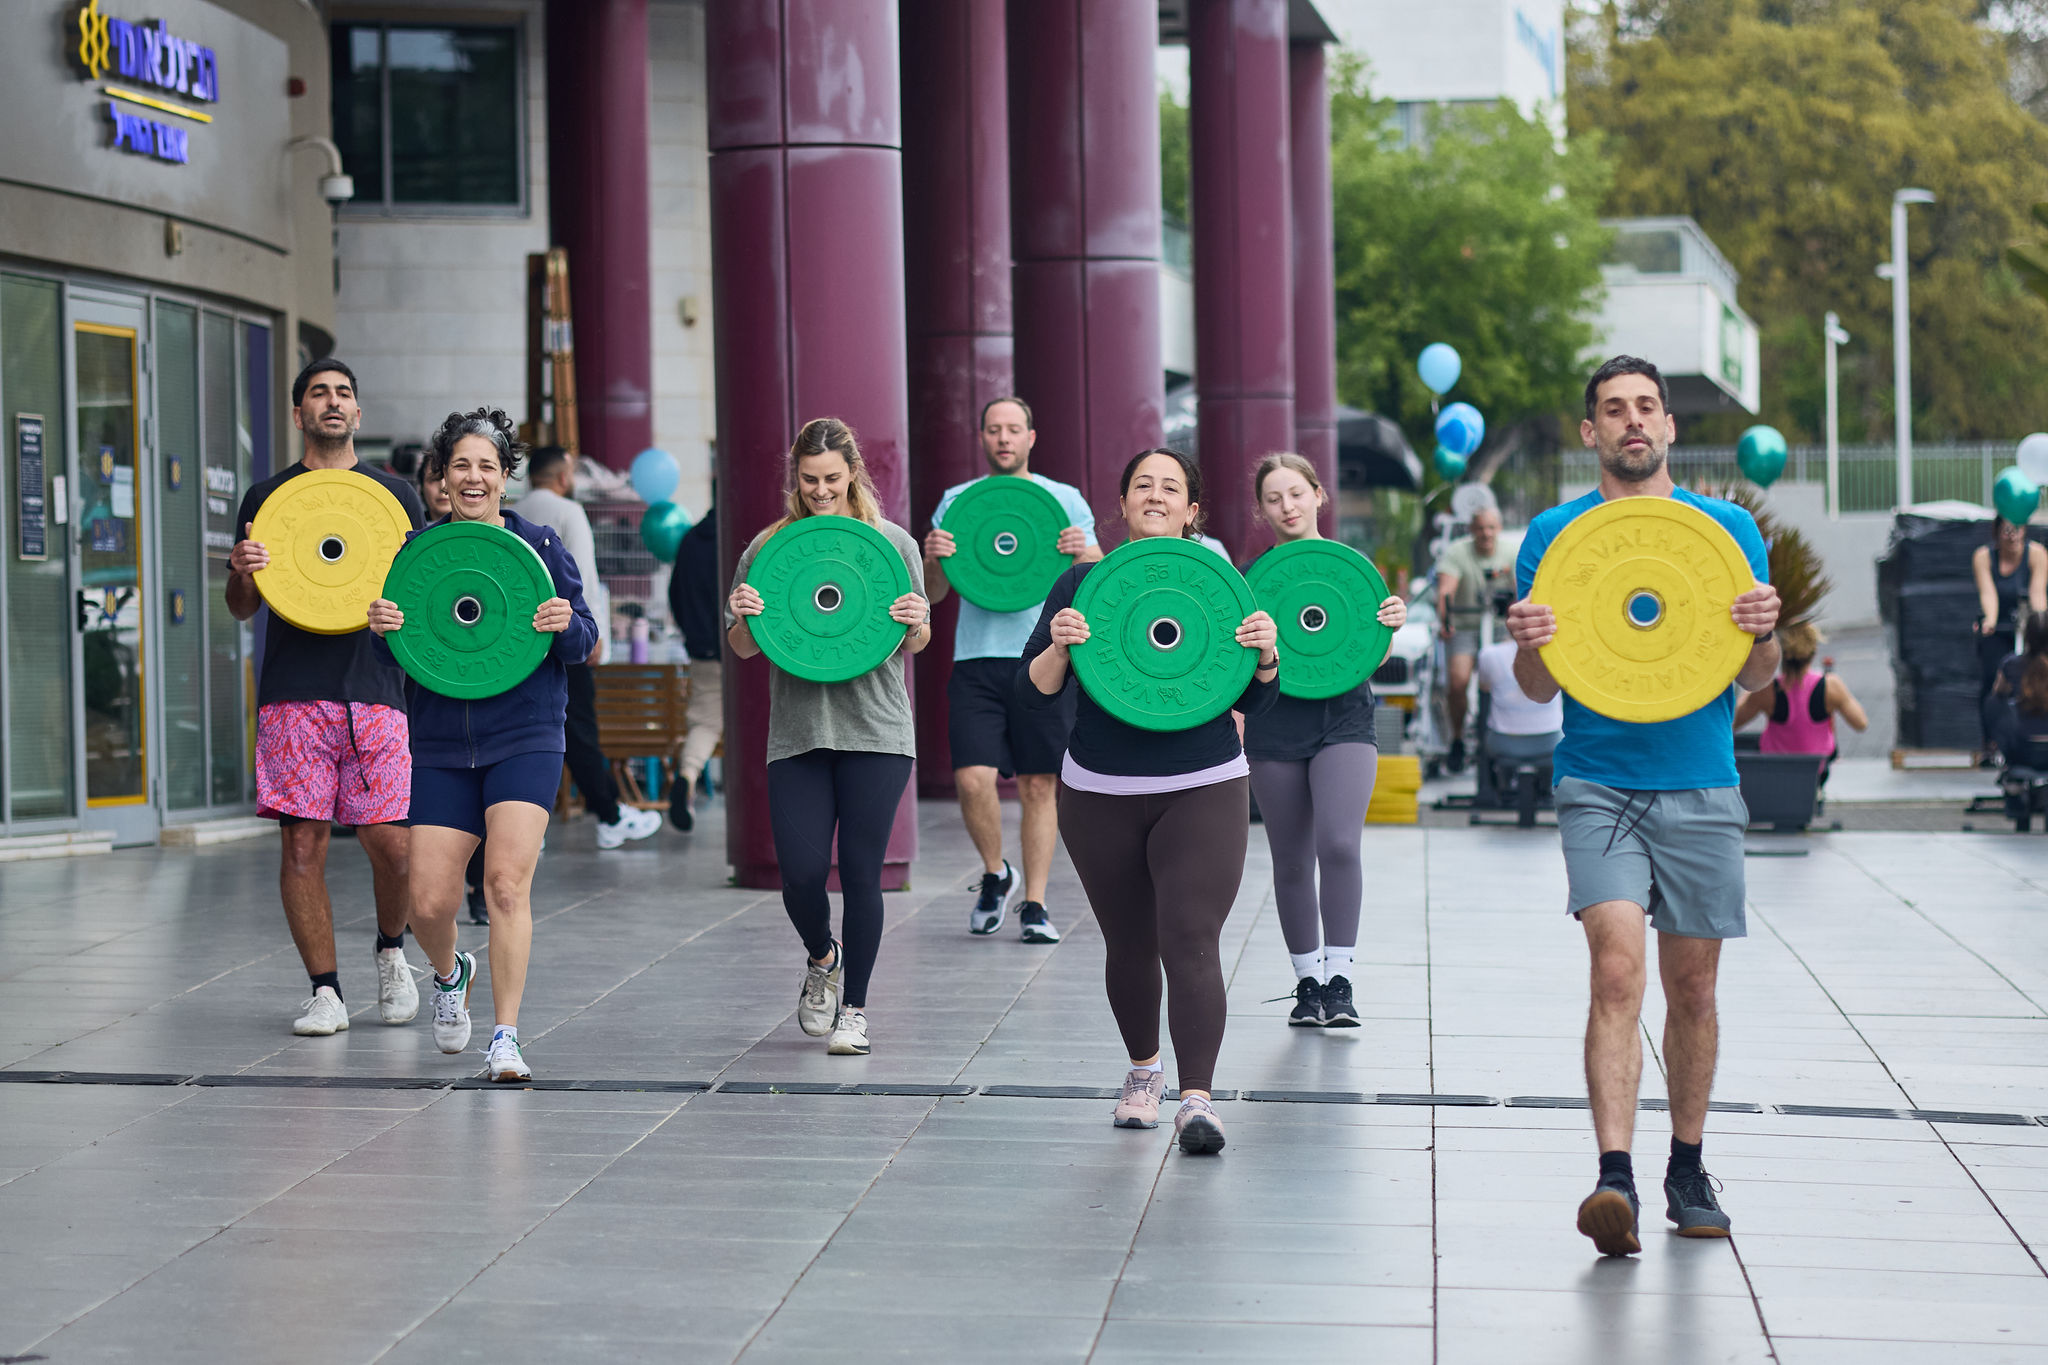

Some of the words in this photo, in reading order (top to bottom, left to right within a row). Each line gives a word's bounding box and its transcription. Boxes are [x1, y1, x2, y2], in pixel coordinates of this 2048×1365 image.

[110, 17, 219, 103] הבינלאומי
[406, 545, 480, 641] VALHALLA
[766, 537, 845, 629] VALHALLA
[811, 571, 889, 660] VALHALLA
[1280, 561, 1370, 631] VALHALLA
[1590, 528, 1728, 617] VALHALLA
[457, 574, 531, 676] VALHALLA
[1095, 577, 1151, 703] VALHALLA
[1177, 565, 1236, 692] VALHALLA
[1562, 605, 1699, 693] VALHALLA
